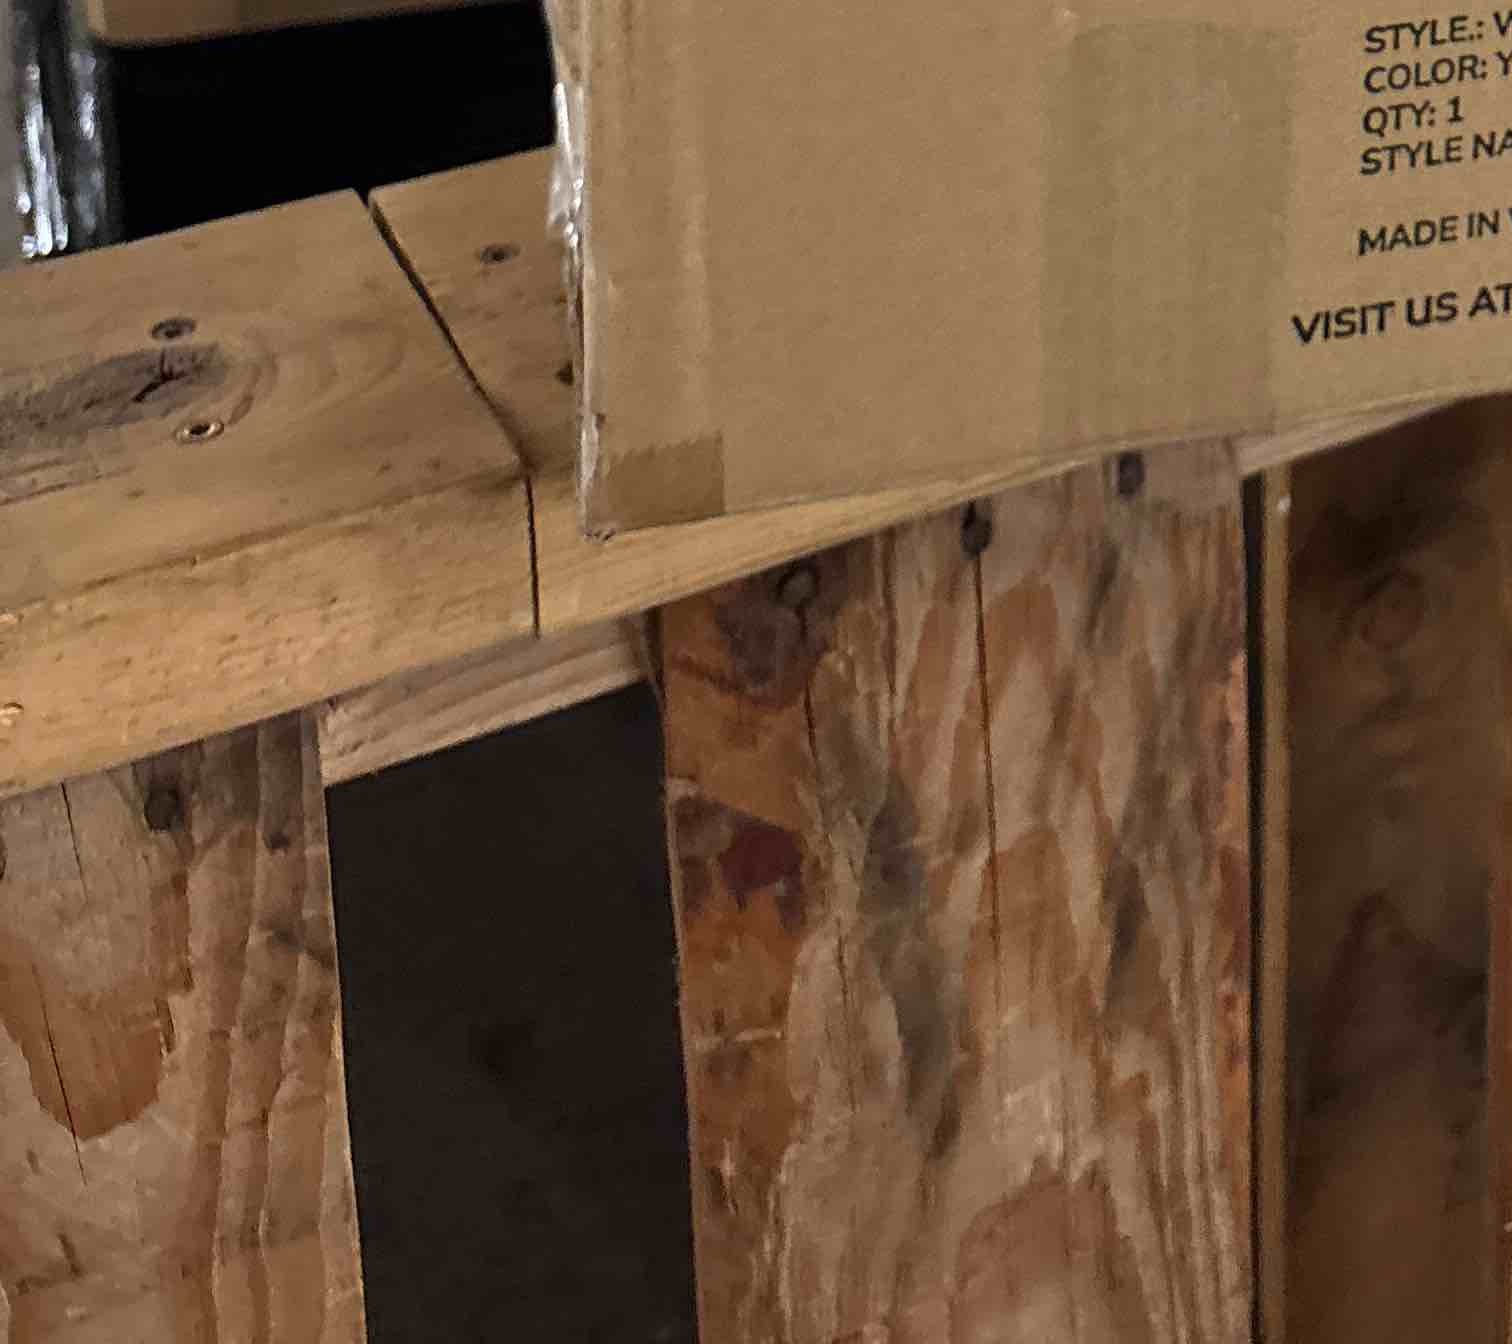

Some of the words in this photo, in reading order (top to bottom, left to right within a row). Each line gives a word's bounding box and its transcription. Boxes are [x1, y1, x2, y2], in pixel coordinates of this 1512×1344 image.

[1363, 53, 1488, 95] COLOR:
[1362, 99, 1436, 139] QTY:
[1447, 95, 1465, 125] 1
[1359, 135, 1464, 176] STYLE
[1357, 215, 1460, 257] MADE
[1466, 209, 1501, 239] IN
[1290, 300, 1396, 347] VISIT
[1405, 291, 1460, 329] US
